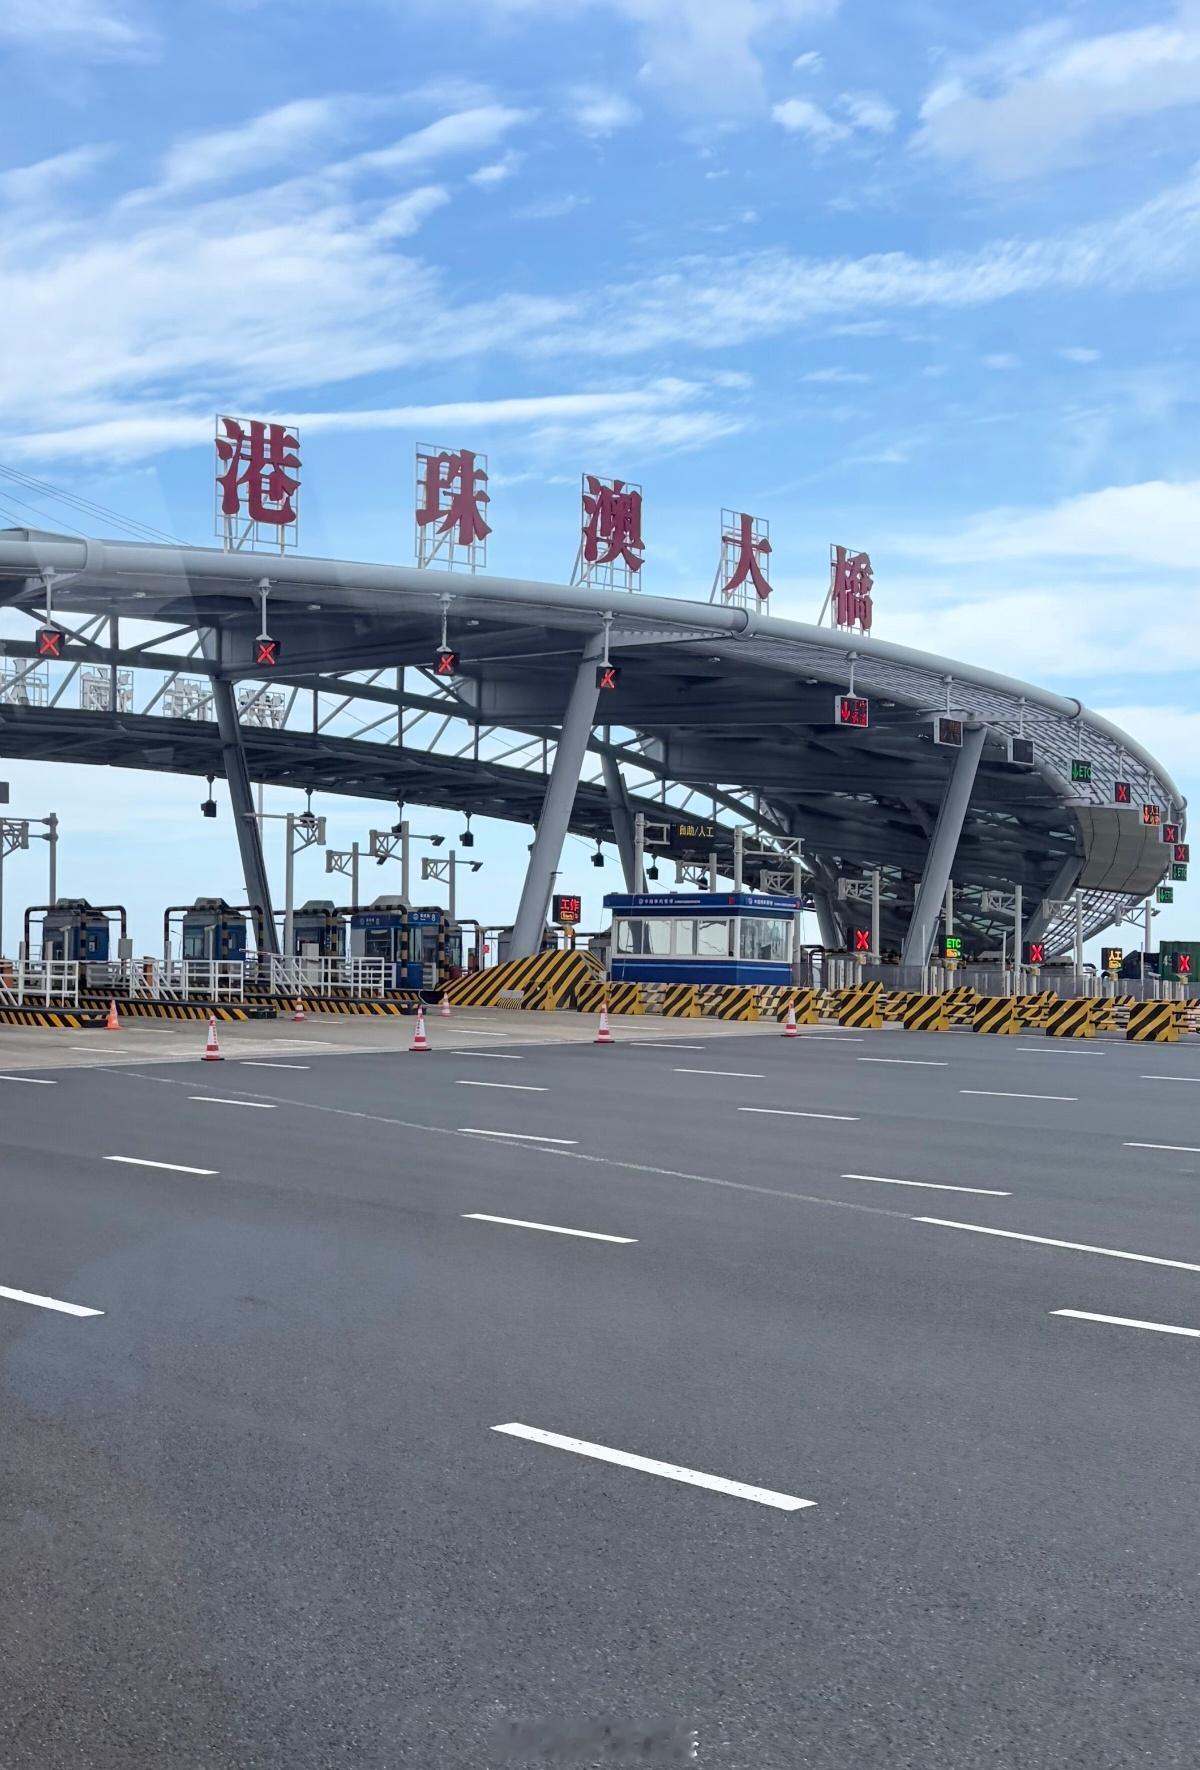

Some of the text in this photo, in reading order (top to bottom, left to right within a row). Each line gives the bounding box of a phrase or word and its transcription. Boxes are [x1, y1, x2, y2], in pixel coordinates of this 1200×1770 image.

[680, 824, 714, 838] 自助/人工
[947, 938, 961, 949] ETC
[1109, 950, 1121, 961] 人工
